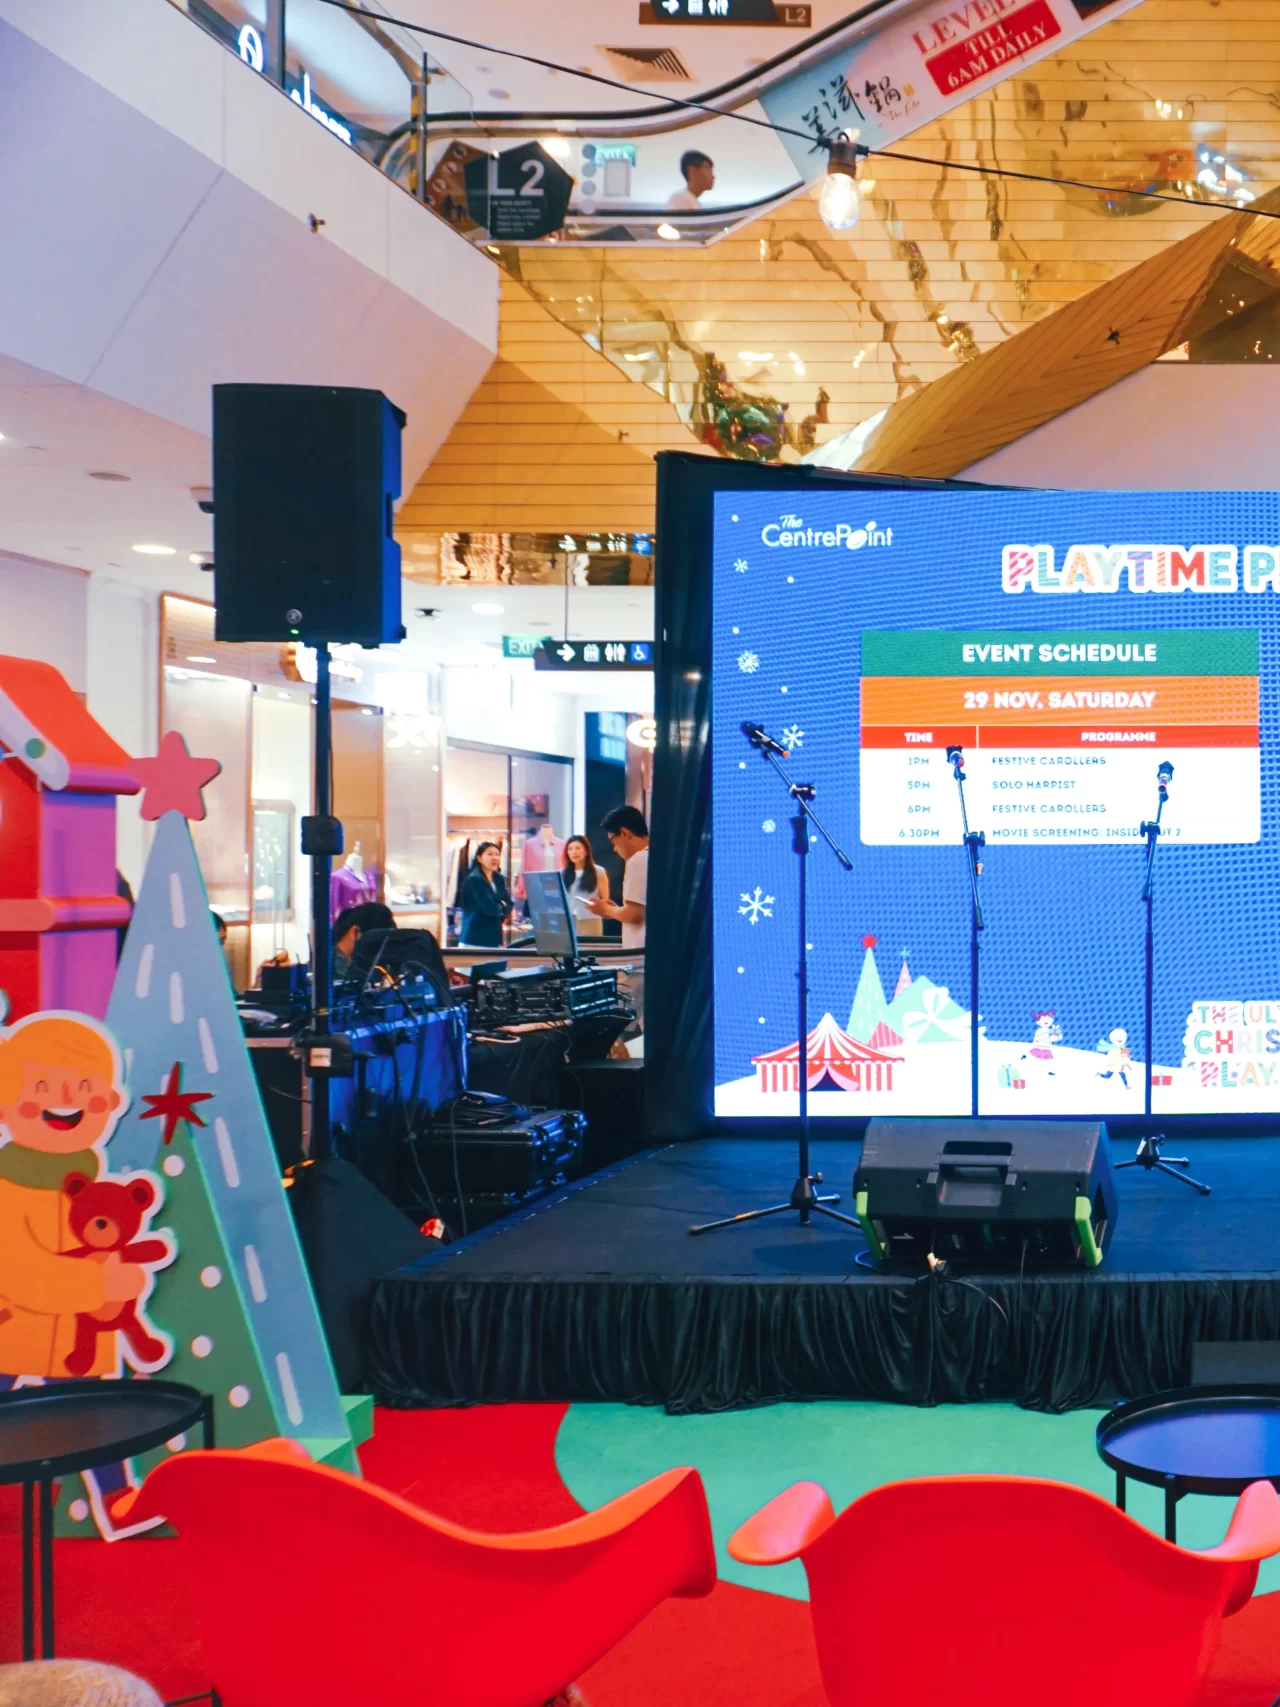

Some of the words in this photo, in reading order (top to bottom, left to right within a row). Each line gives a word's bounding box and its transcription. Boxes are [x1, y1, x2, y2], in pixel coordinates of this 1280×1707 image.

[785, 8, 806, 23] L2
[965, 23, 1013, 56] TILL
[947, 55, 989, 87] 6AM
[989, 21, 1047, 64] DAILY
[488, 159, 545, 196] L2
[779, 514, 803, 528] The
[761, 521, 894, 550] CentrePoint
[1006, 549, 1234, 588] PLAYTIME
[962, 643, 1034, 662] EVENT
[1038, 643, 1157, 662] SCHEDULE
[963, 692, 989, 709] 29
[993, 691, 1043, 710] NOV,
[1048, 691, 1156, 709] SATURDAY
[904, 731, 933, 743] TIME
[1081, 731, 1156, 742] PROGRAMME
[908, 757, 930, 766] 1PM
[992, 757, 1036, 766] FESTIVE
[1040, 757, 1106, 766] CAROLLERS
[907, 781, 931, 790] 5PM
[992, 781, 1023, 789] SOLO
[1026, 780, 1076, 789] HARPIST
[907, 804, 931, 814] 6PM
[992, 804, 1036, 813] FESTIVE
[1040, 804, 1107, 813] CAROLLERS
[898, 829, 940, 838] 6.30PM
[992, 828, 1029, 837] MOVIE
[1032, 828, 1103, 837] SCREENING:
[1106, 828, 1142, 837] INSID
[1175, 828, 1181, 837] 2
[1197, 1005, 1240, 1024] THE
